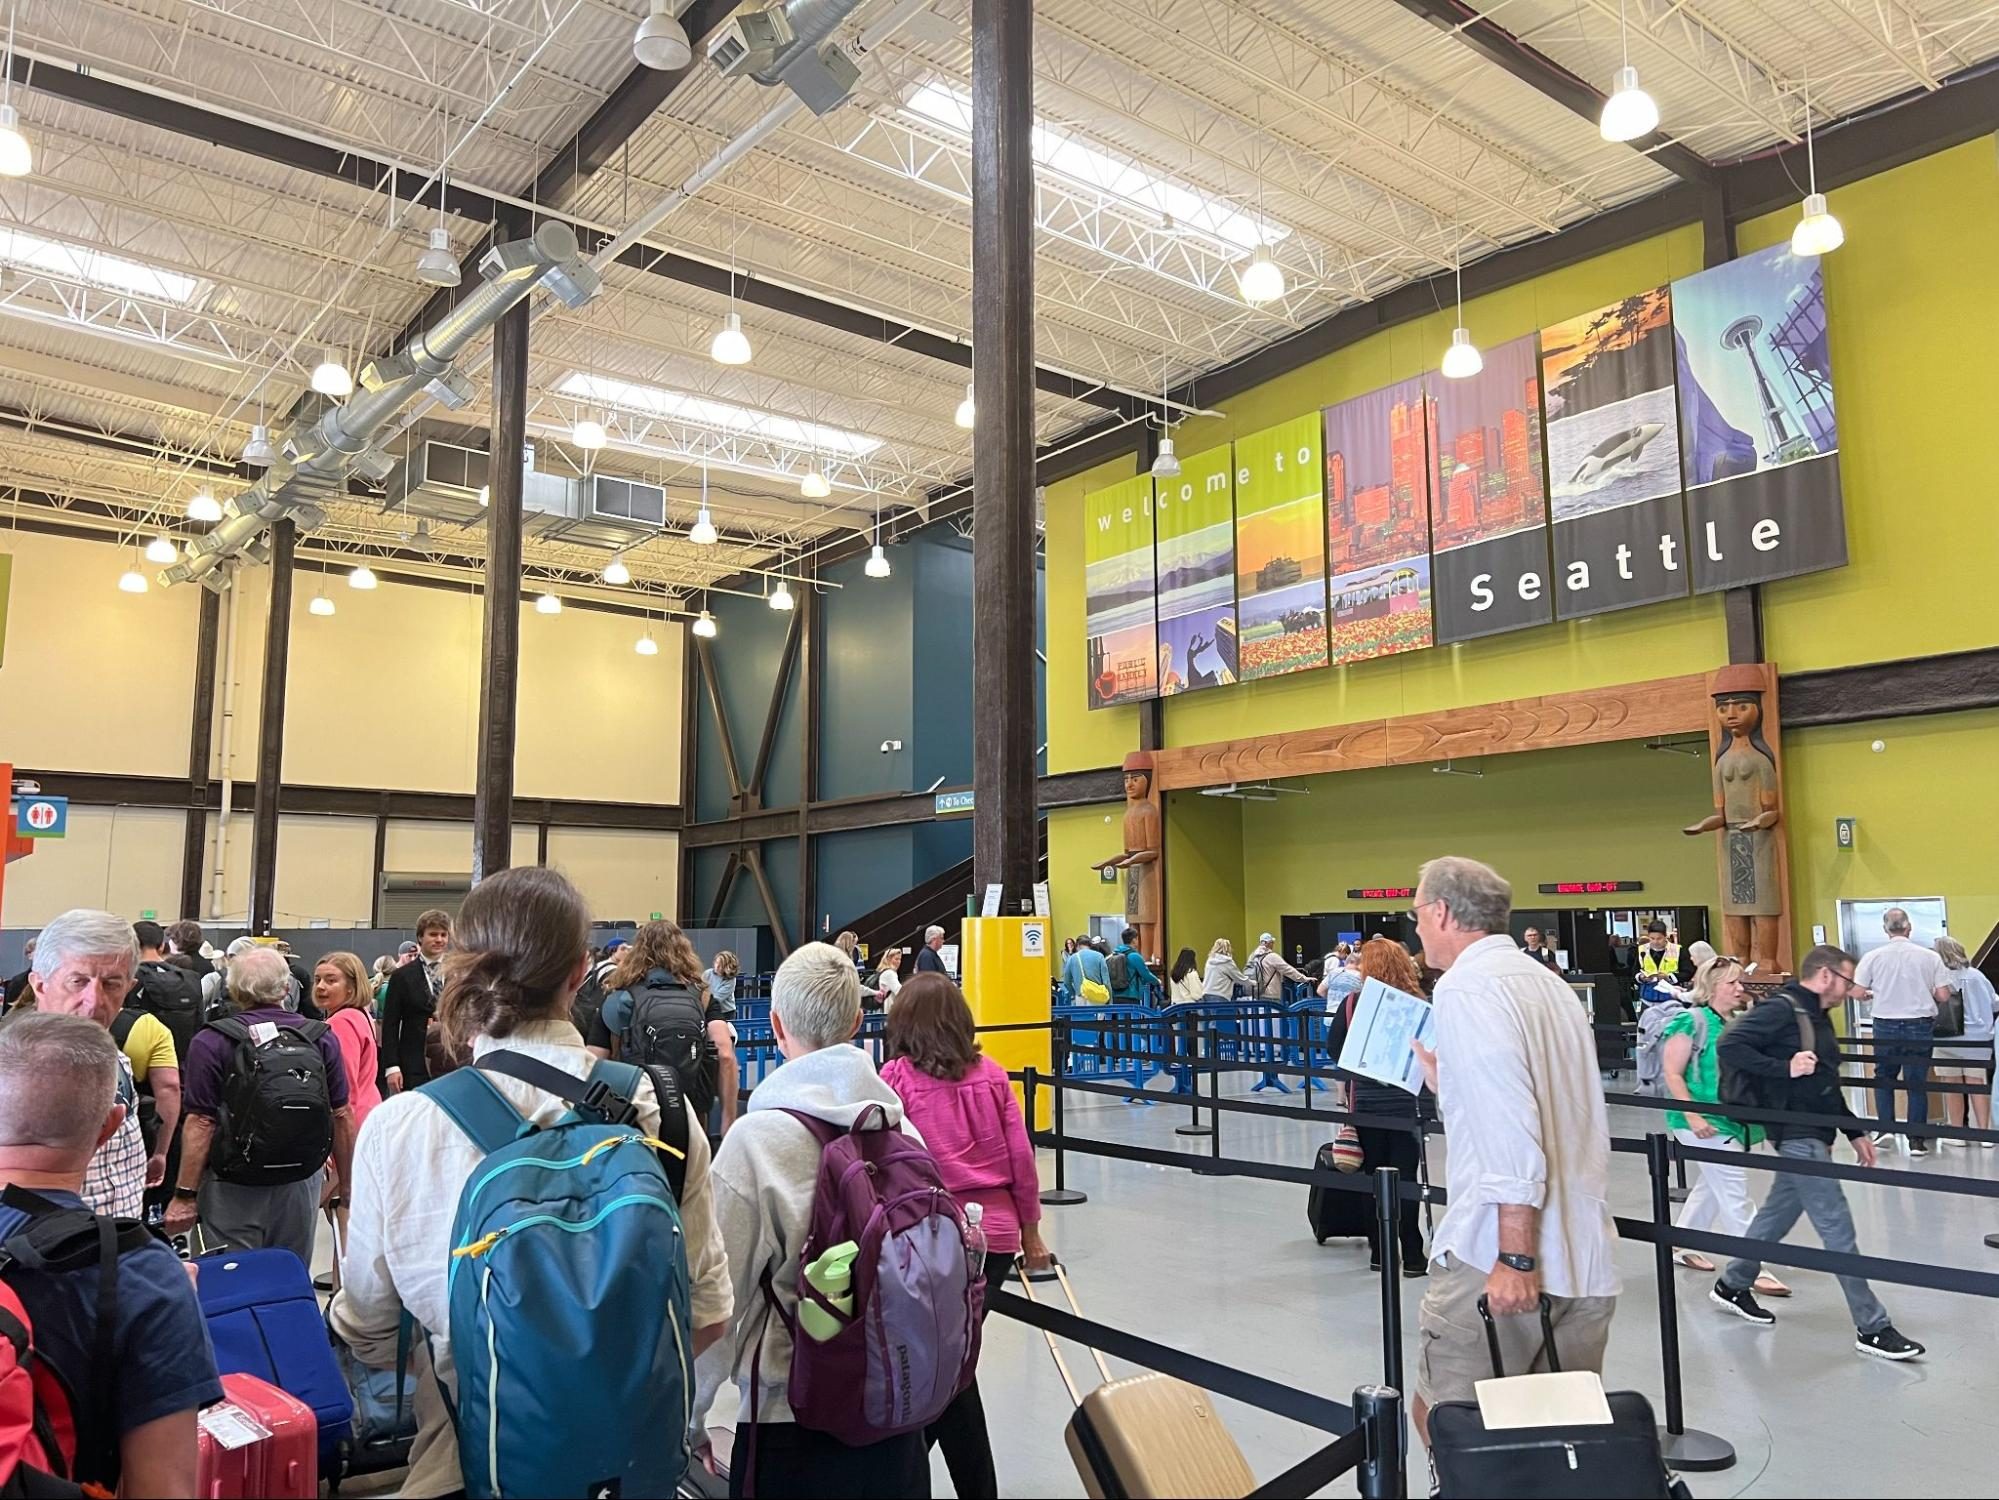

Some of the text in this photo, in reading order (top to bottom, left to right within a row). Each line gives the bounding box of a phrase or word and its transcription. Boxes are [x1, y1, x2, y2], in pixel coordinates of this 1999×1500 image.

[1097, 447, 1310, 532] welcome to
[1469, 518, 1781, 613] Seattle
